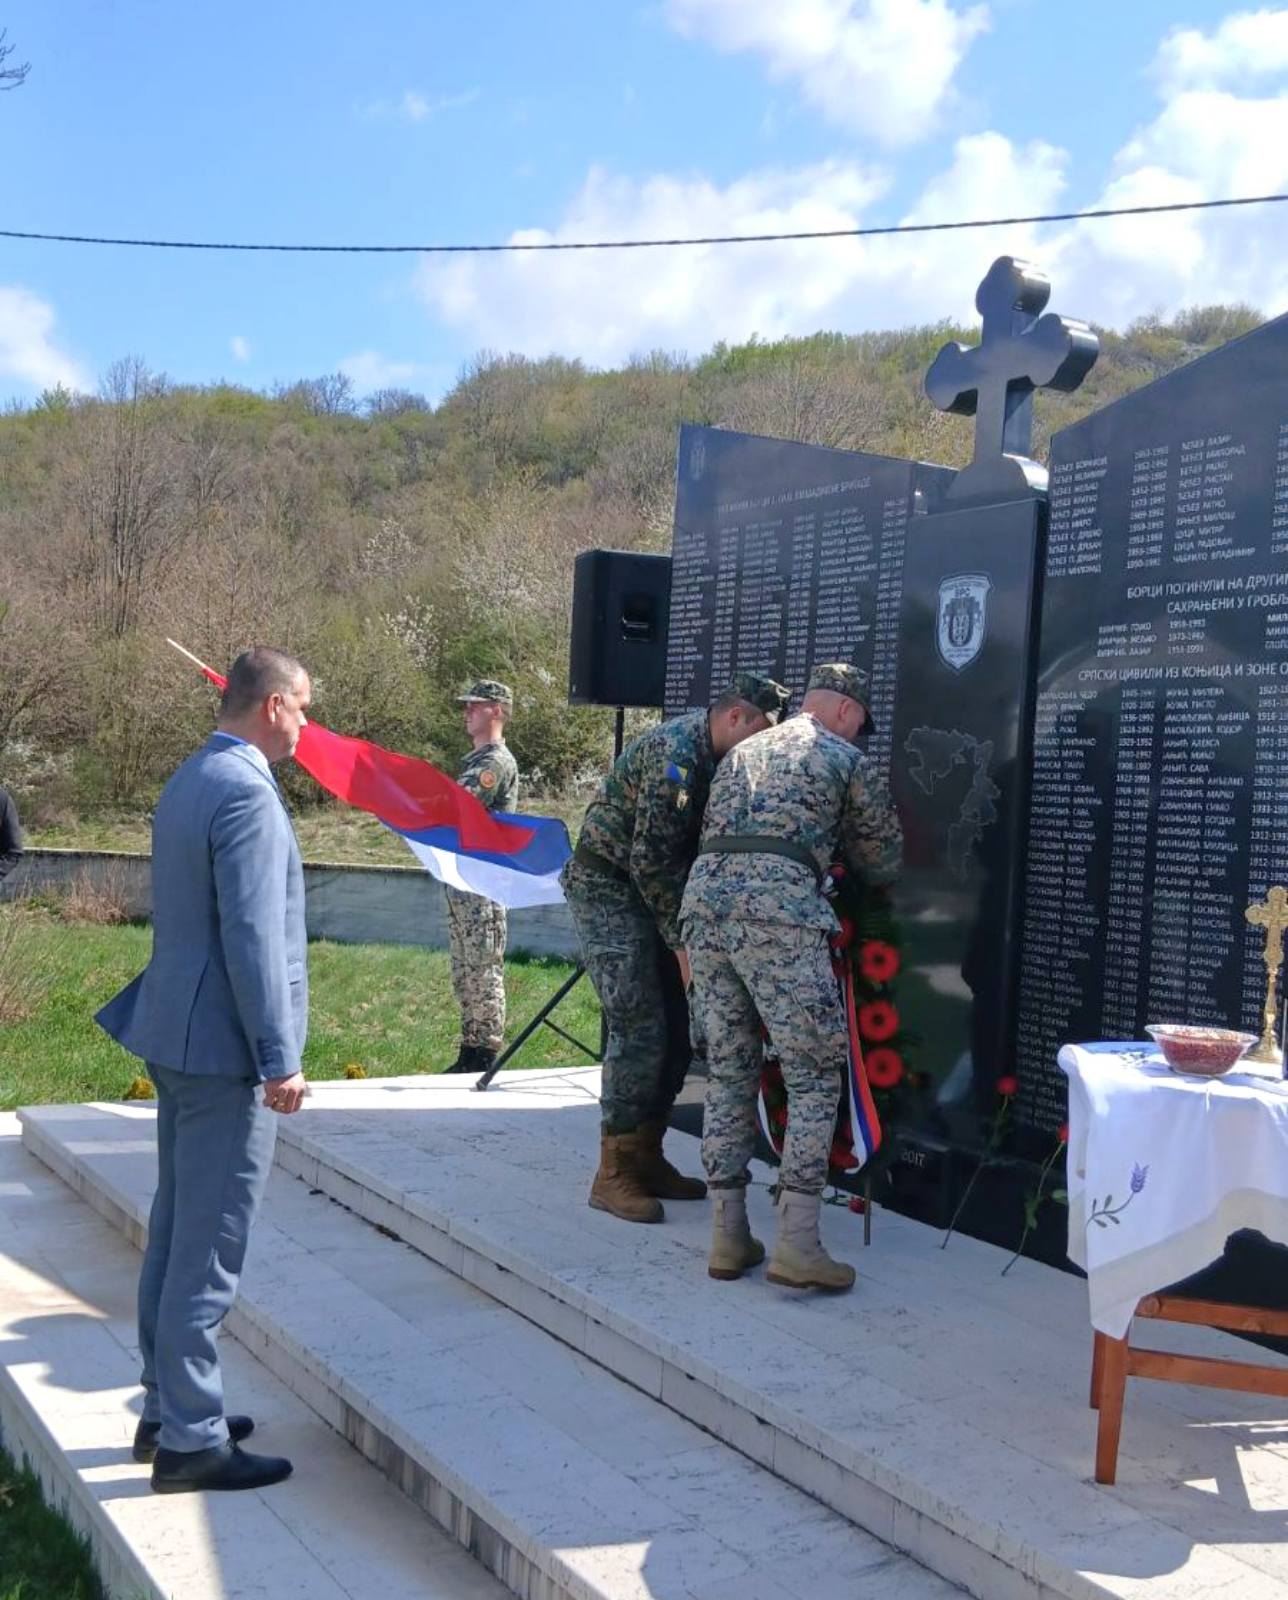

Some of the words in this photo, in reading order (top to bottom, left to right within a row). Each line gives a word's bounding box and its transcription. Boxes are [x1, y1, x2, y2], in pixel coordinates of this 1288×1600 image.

[1127, 583, 1163, 599] БОРЦИ
[1166, 578, 1224, 595] ПОГИНУЛИ
[1228, 577, 1243, 589] НА
[1168, 597, 1235, 614] САХРАЊЕНИ
[1237, 596, 1245, 609] У
[1078, 669, 1117, 683] СРПСКИ
[1119, 667, 1163, 682] ЦИВИЛИ
[1166, 666, 1180, 680] ИЗ
[1182, 664, 1231, 680] КОЊИЦА
[1234, 662, 1243, 676] И
[1246, 661, 1277, 676] ЗОНЕ
